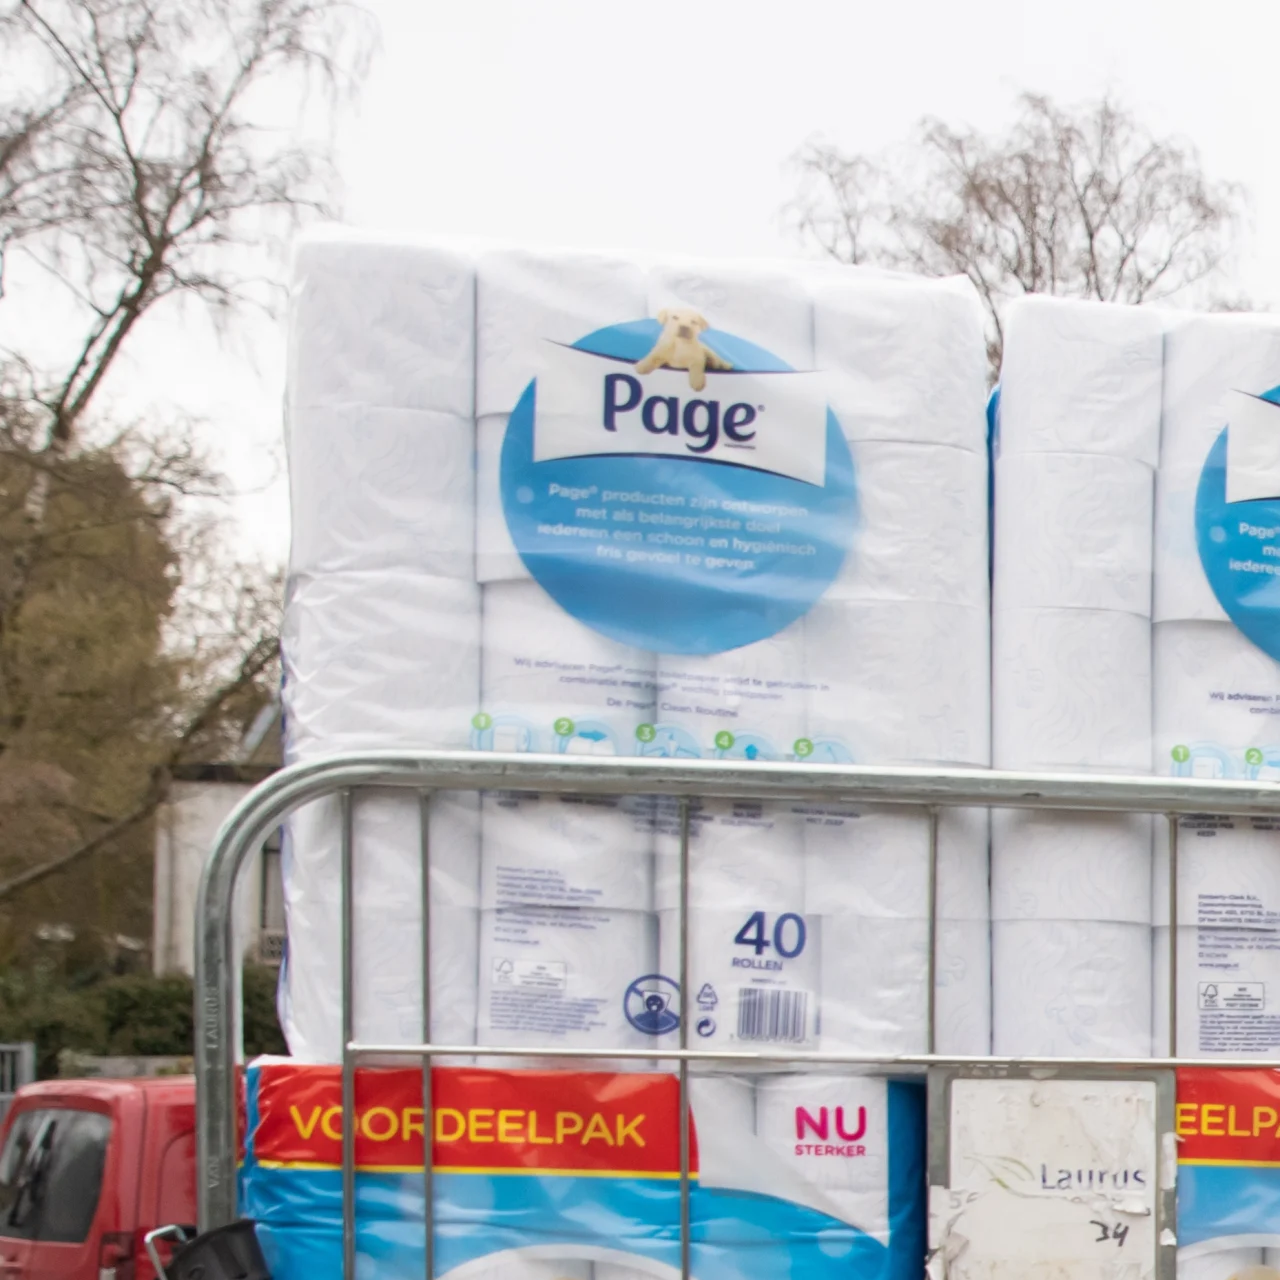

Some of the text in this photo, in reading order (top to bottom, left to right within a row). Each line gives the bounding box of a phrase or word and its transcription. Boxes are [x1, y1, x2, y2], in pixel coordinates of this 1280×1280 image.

[734, 910, 807, 959] 40
[731, 956, 783, 972] ROLLEN
[290, 1104, 646, 1148] VOORDEELPAK
[795, 1105, 867, 1141] NU
[794, 1142, 866, 1159] STERKER
[1041, 1163, 1146, 1190] Laurus
